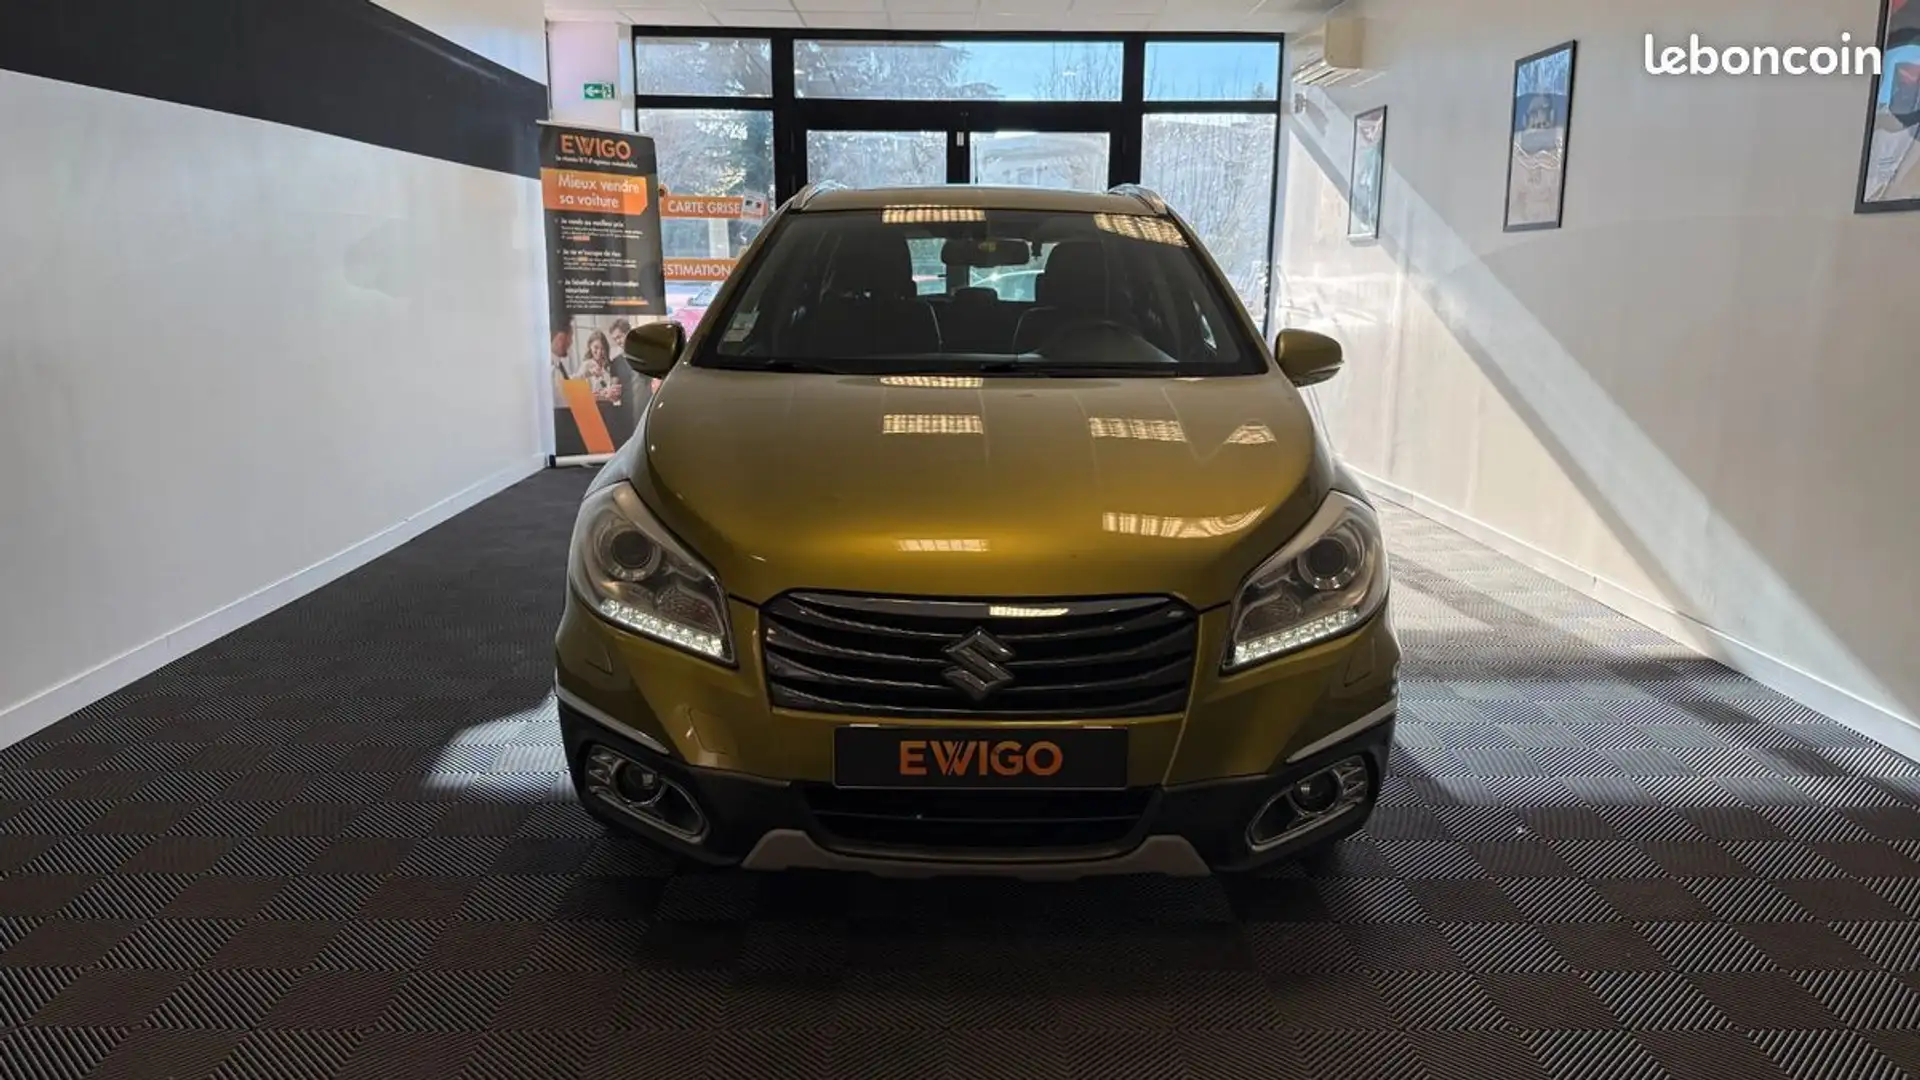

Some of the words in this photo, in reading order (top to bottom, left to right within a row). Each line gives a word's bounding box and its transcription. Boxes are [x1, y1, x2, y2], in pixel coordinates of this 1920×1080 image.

[560, 134, 631, 160] EWIGO
[558, 173, 597, 190] Mieux
[600, 178, 640, 194] vendre
[559, 195, 574, 205] sa
[577, 192, 620, 208] voiture
[667, 199, 705, 214] CARTE
[707, 201, 741, 214] GRISE
[900, 740, 1063, 776] EWIGO
